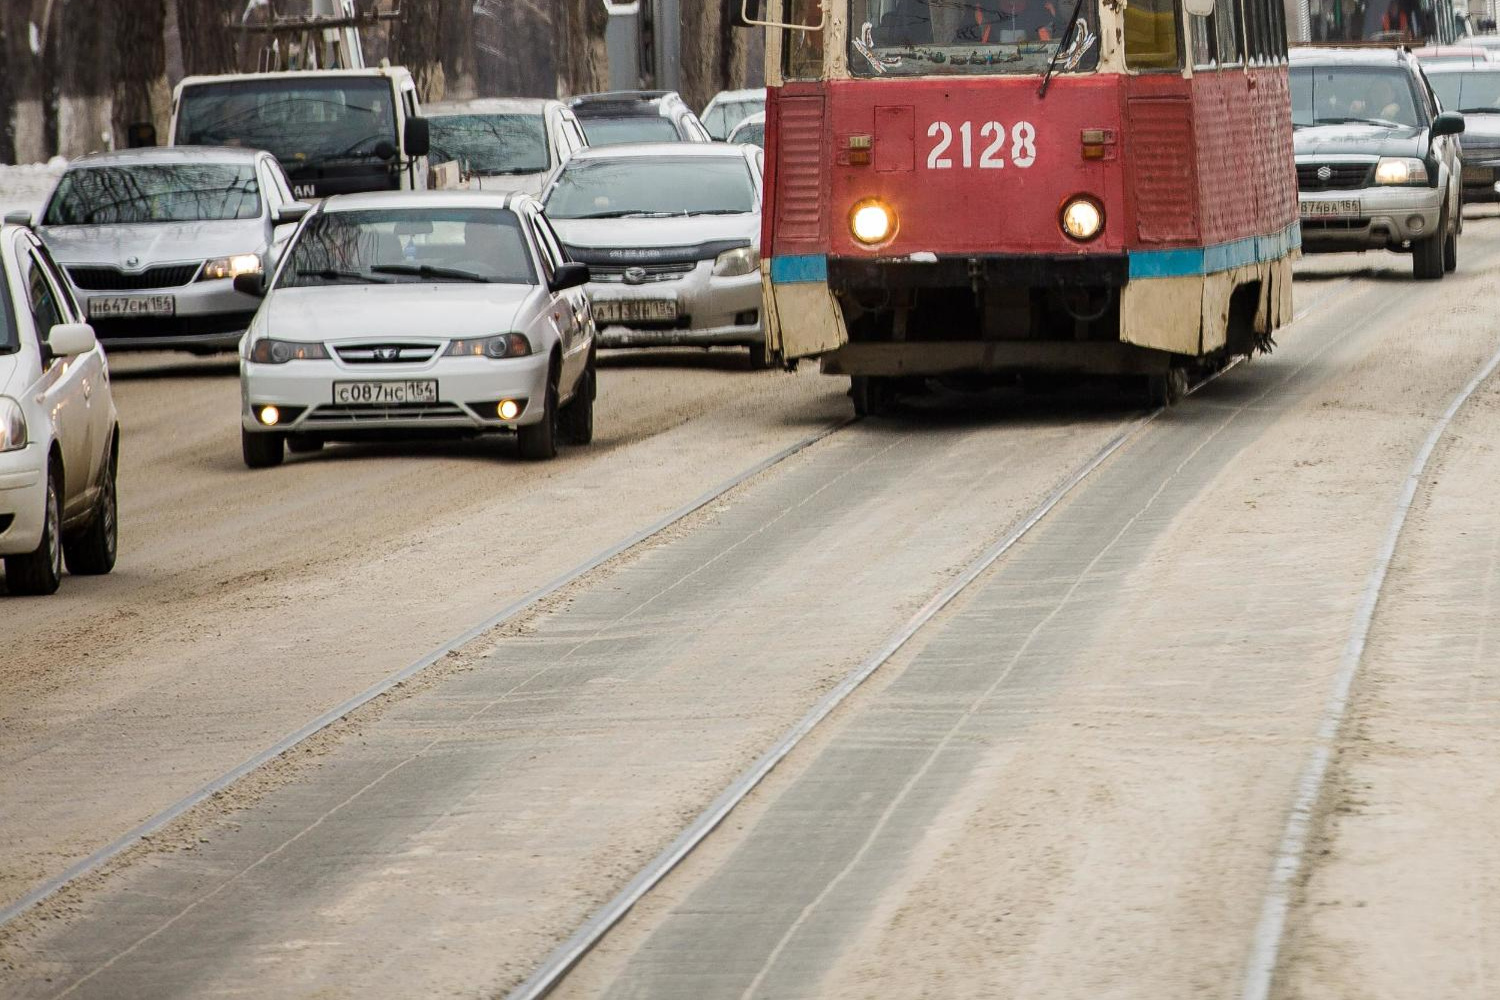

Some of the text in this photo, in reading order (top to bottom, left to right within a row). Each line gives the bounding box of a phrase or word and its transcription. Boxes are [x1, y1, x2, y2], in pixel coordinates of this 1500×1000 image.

[927, 121, 1037, 170] 2128
[294, 184, 315, 198] AN
[1300, 201, 1338, 215] 874ВА
[339, 380, 433, 402] С087НС 154
